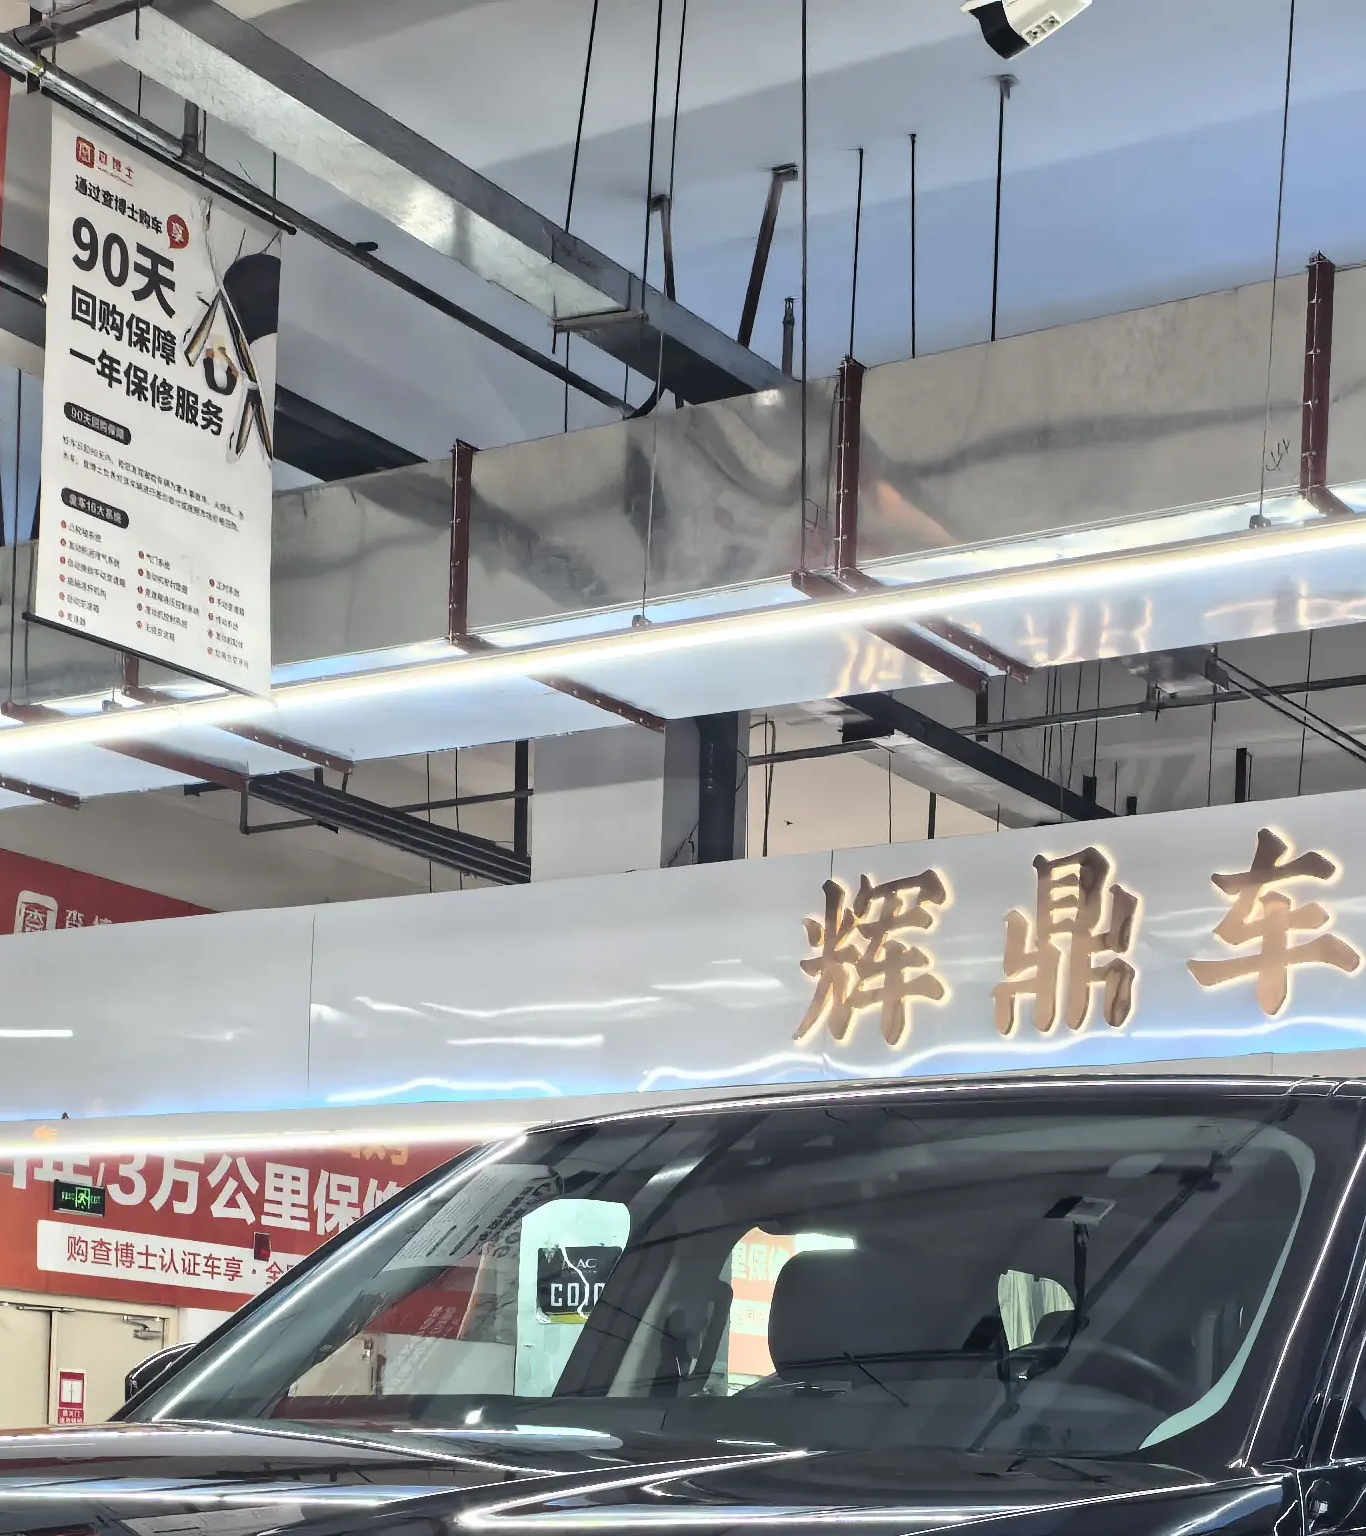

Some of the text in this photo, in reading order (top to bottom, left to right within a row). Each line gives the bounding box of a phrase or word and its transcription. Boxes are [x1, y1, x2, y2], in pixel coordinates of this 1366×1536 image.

[75, 174, 163, 236] 通过查博士购车
[72, 216, 176, 319] 90天
[71, 284, 177, 367] 回购保障
[69, 347, 224, 437] 一年保修服务
[66, 1235, 296, 1286] 购查博士认证车享·全
